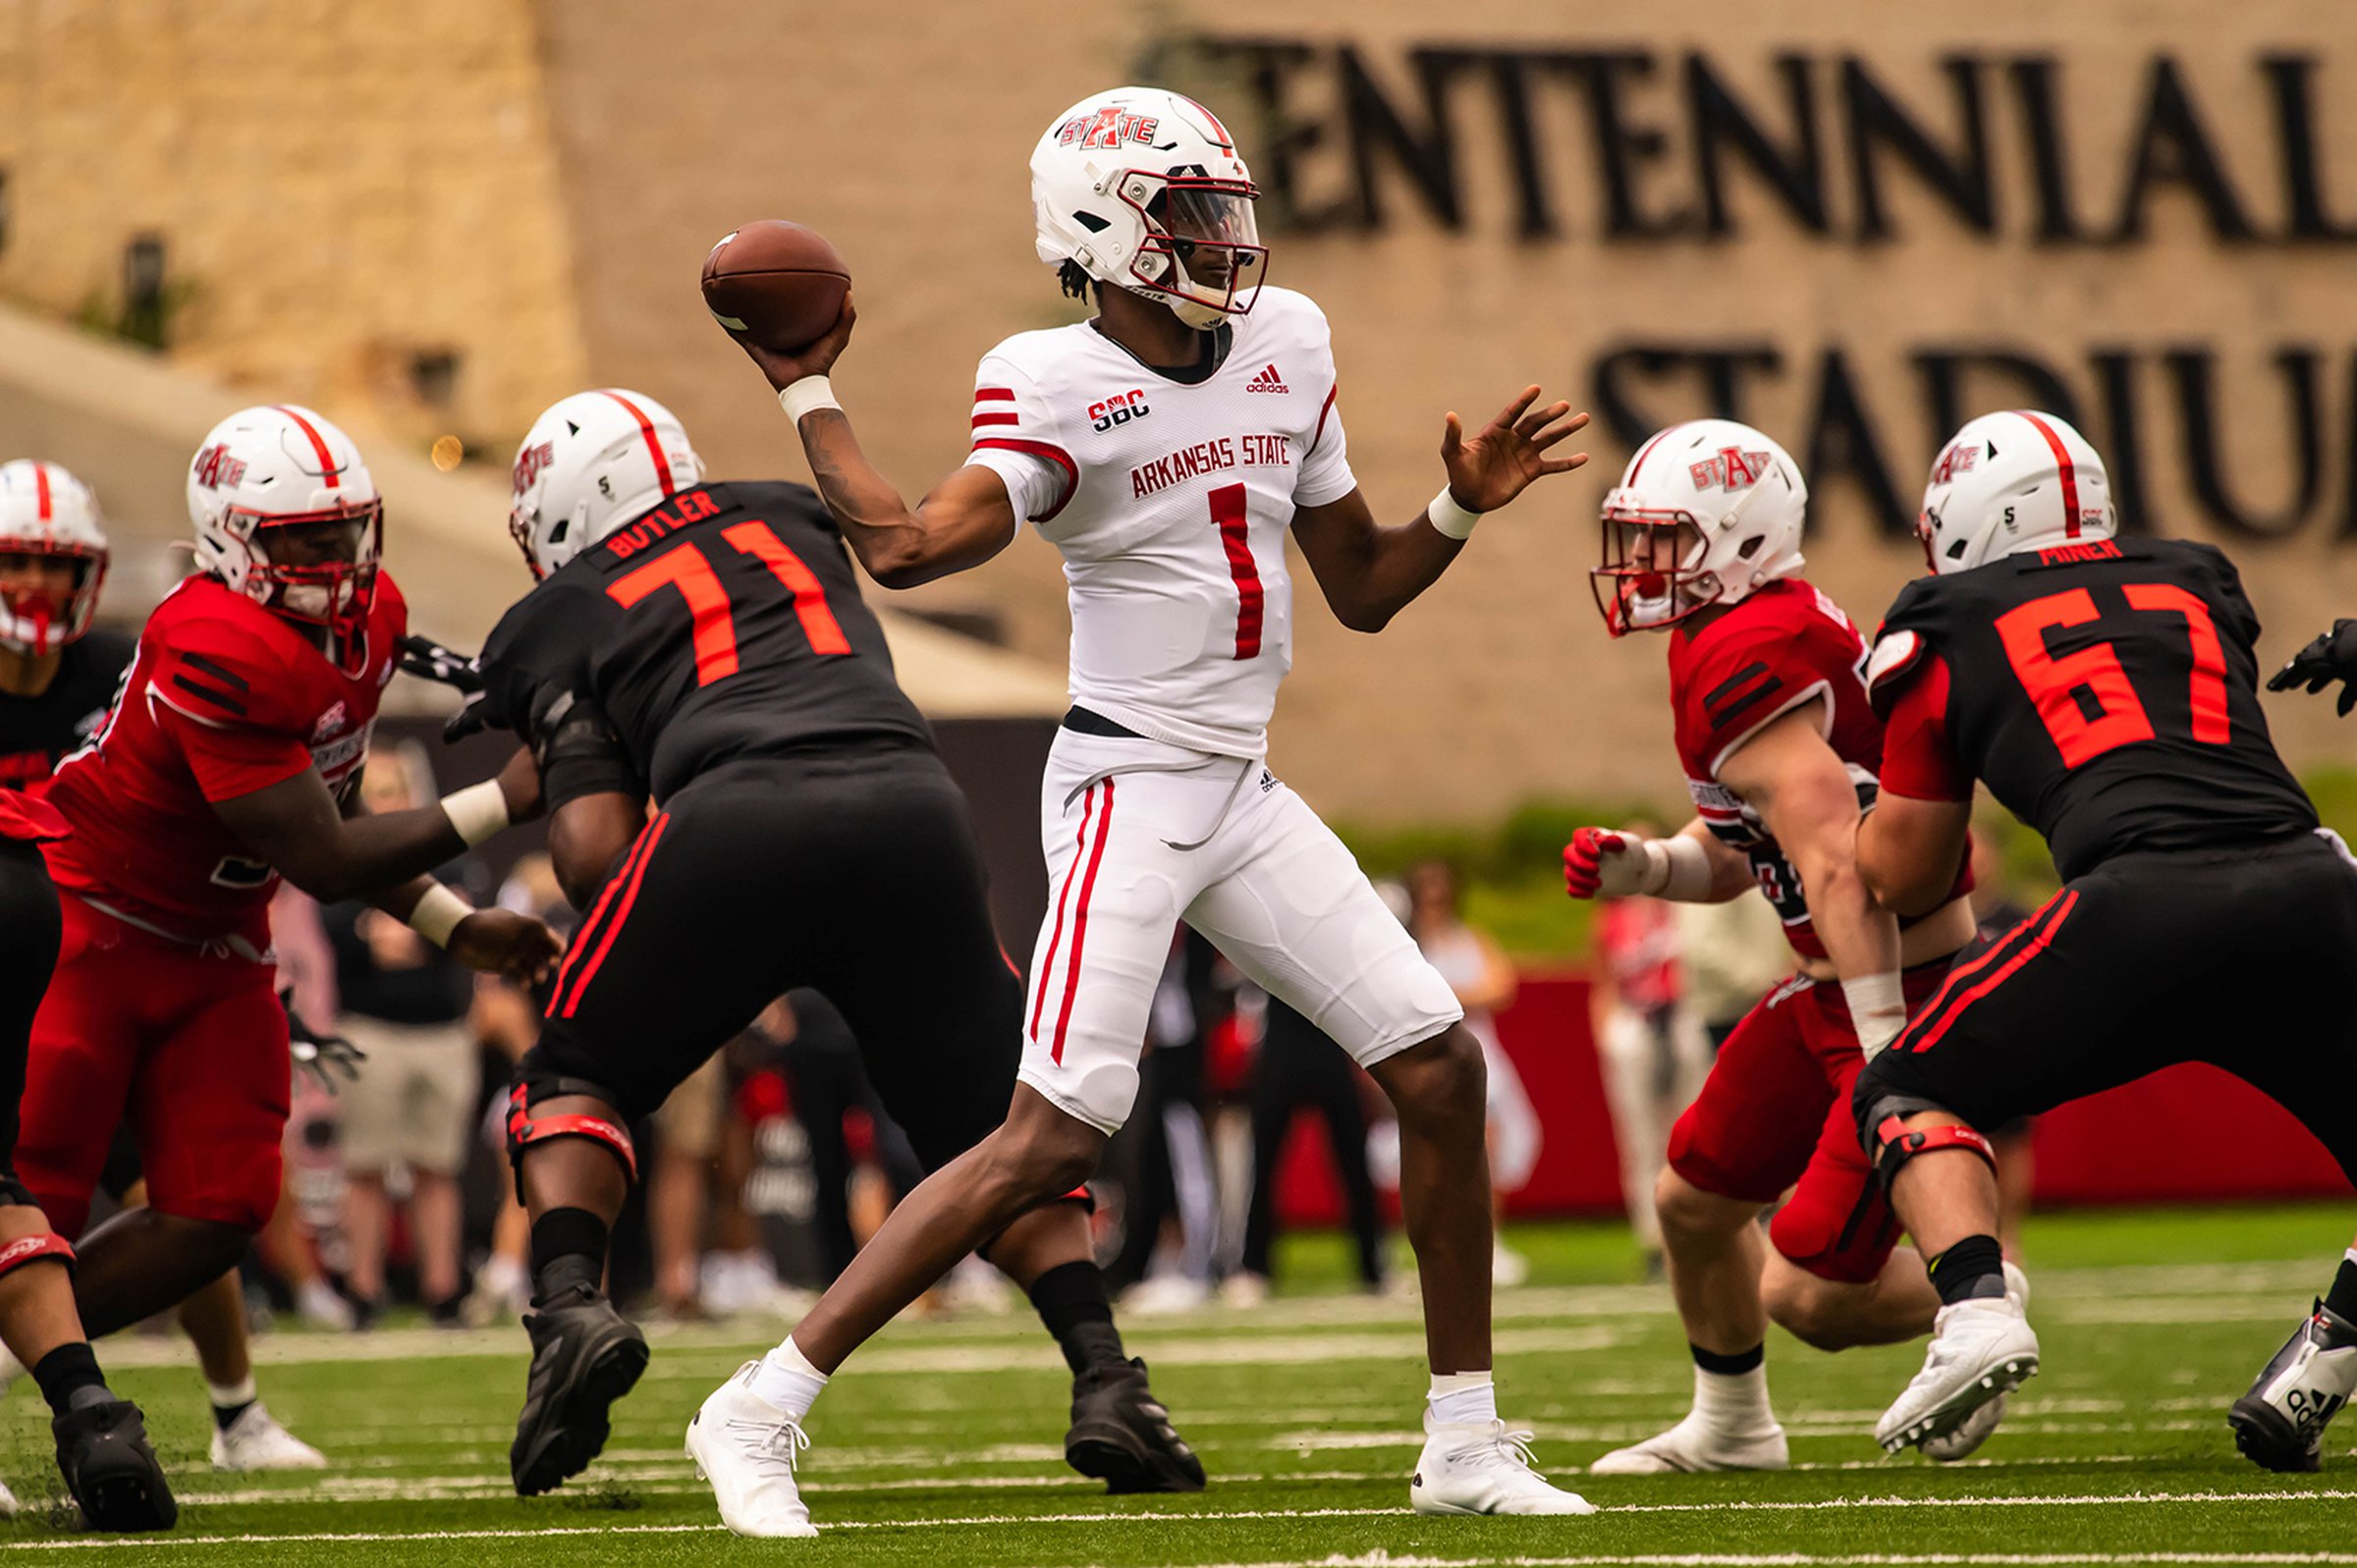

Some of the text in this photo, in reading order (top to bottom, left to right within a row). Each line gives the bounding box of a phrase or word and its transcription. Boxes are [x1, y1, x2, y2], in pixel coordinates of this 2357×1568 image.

[1060, 106, 1159, 150] STATE
[1134, 37, 2357, 253] ENTENNIAL
[1087, 388, 1151, 433] SBC
[1245, 380, 1290, 395] adidas
[513, 440, 554, 497] ATE
[1131, 435, 1290, 499] ARKANSAS STATE
[1585, 340, 2357, 550] STADIU
[1932, 442, 1980, 489] ATE
[606, 490, 720, 559] BUTLER
[605, 519, 851, 687] 71
[1208, 482, 1263, 660] 1
[1996, 583, 2230, 770] 67
